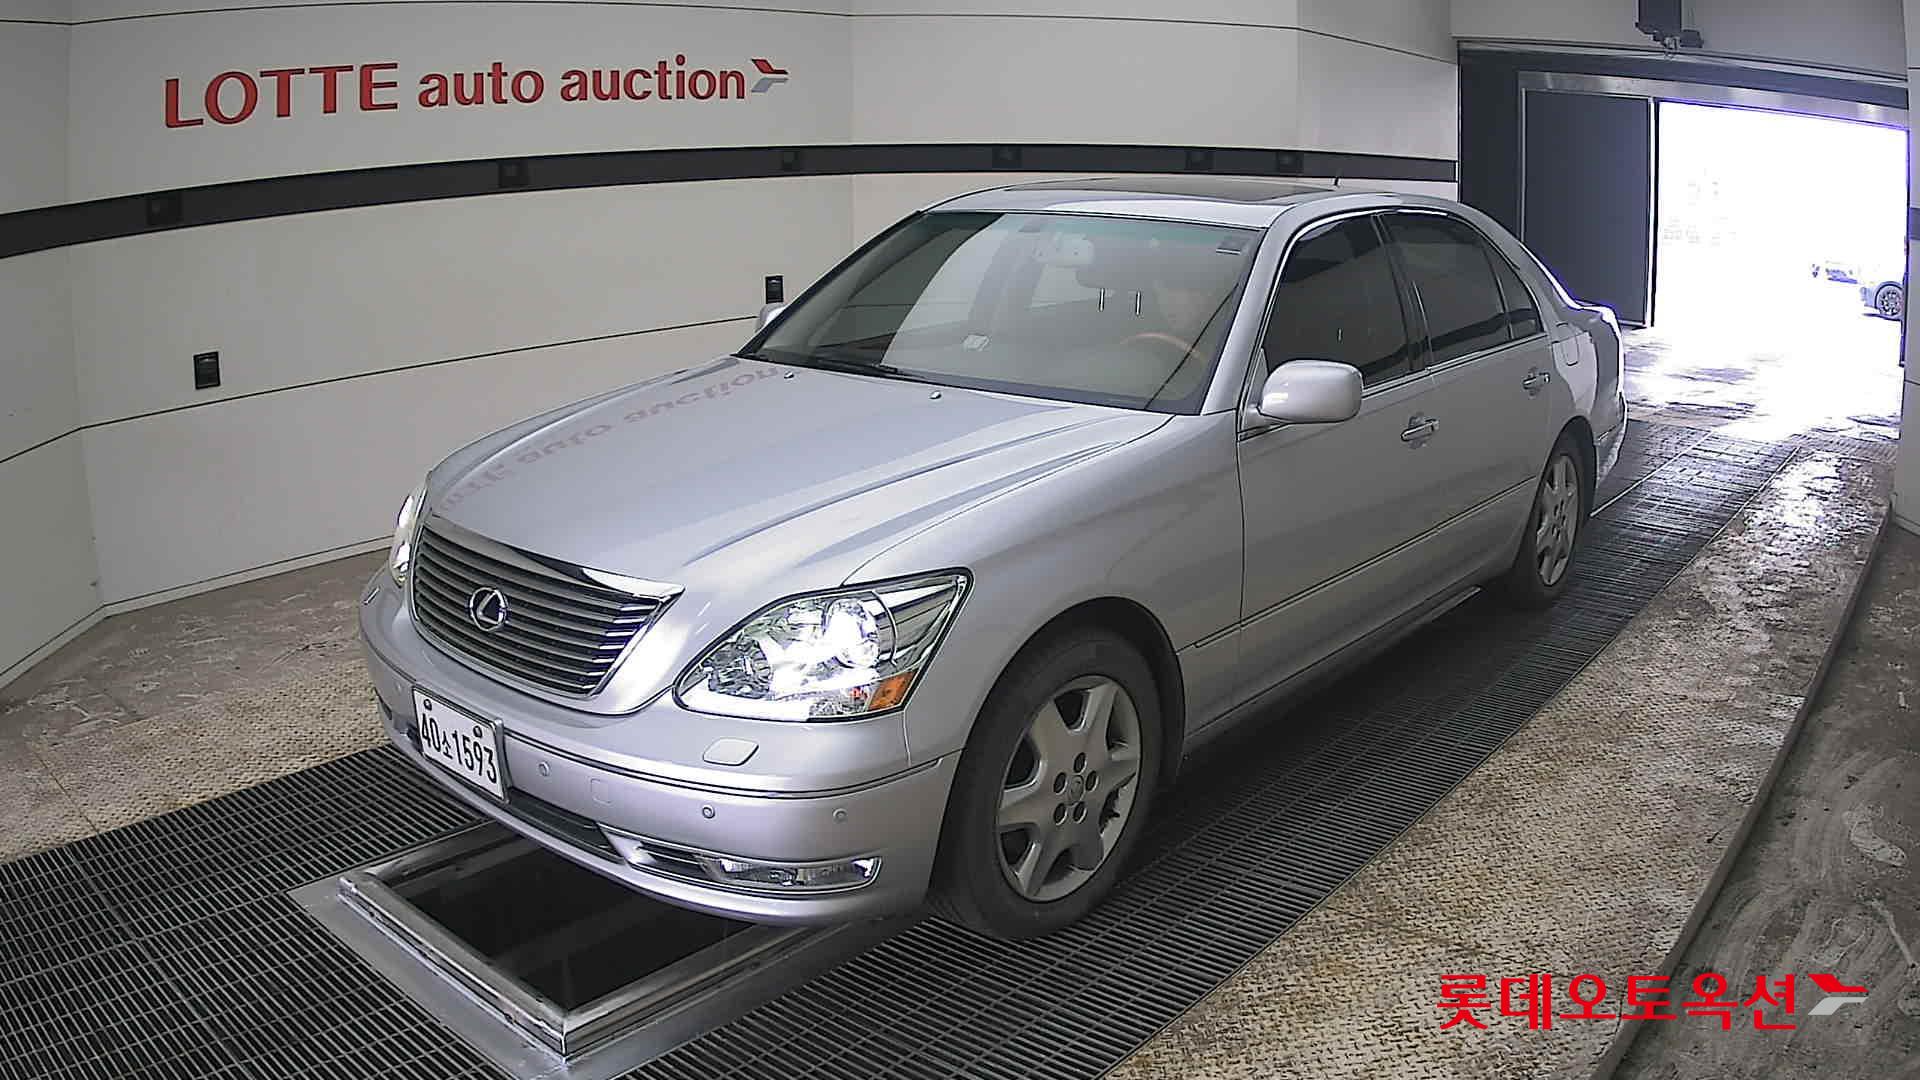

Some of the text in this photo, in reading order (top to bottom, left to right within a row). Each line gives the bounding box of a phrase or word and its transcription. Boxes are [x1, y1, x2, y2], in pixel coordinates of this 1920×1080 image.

[165, 54, 746, 128] LOTTE auto auction
[421, 713, 497, 783] 40소1593
